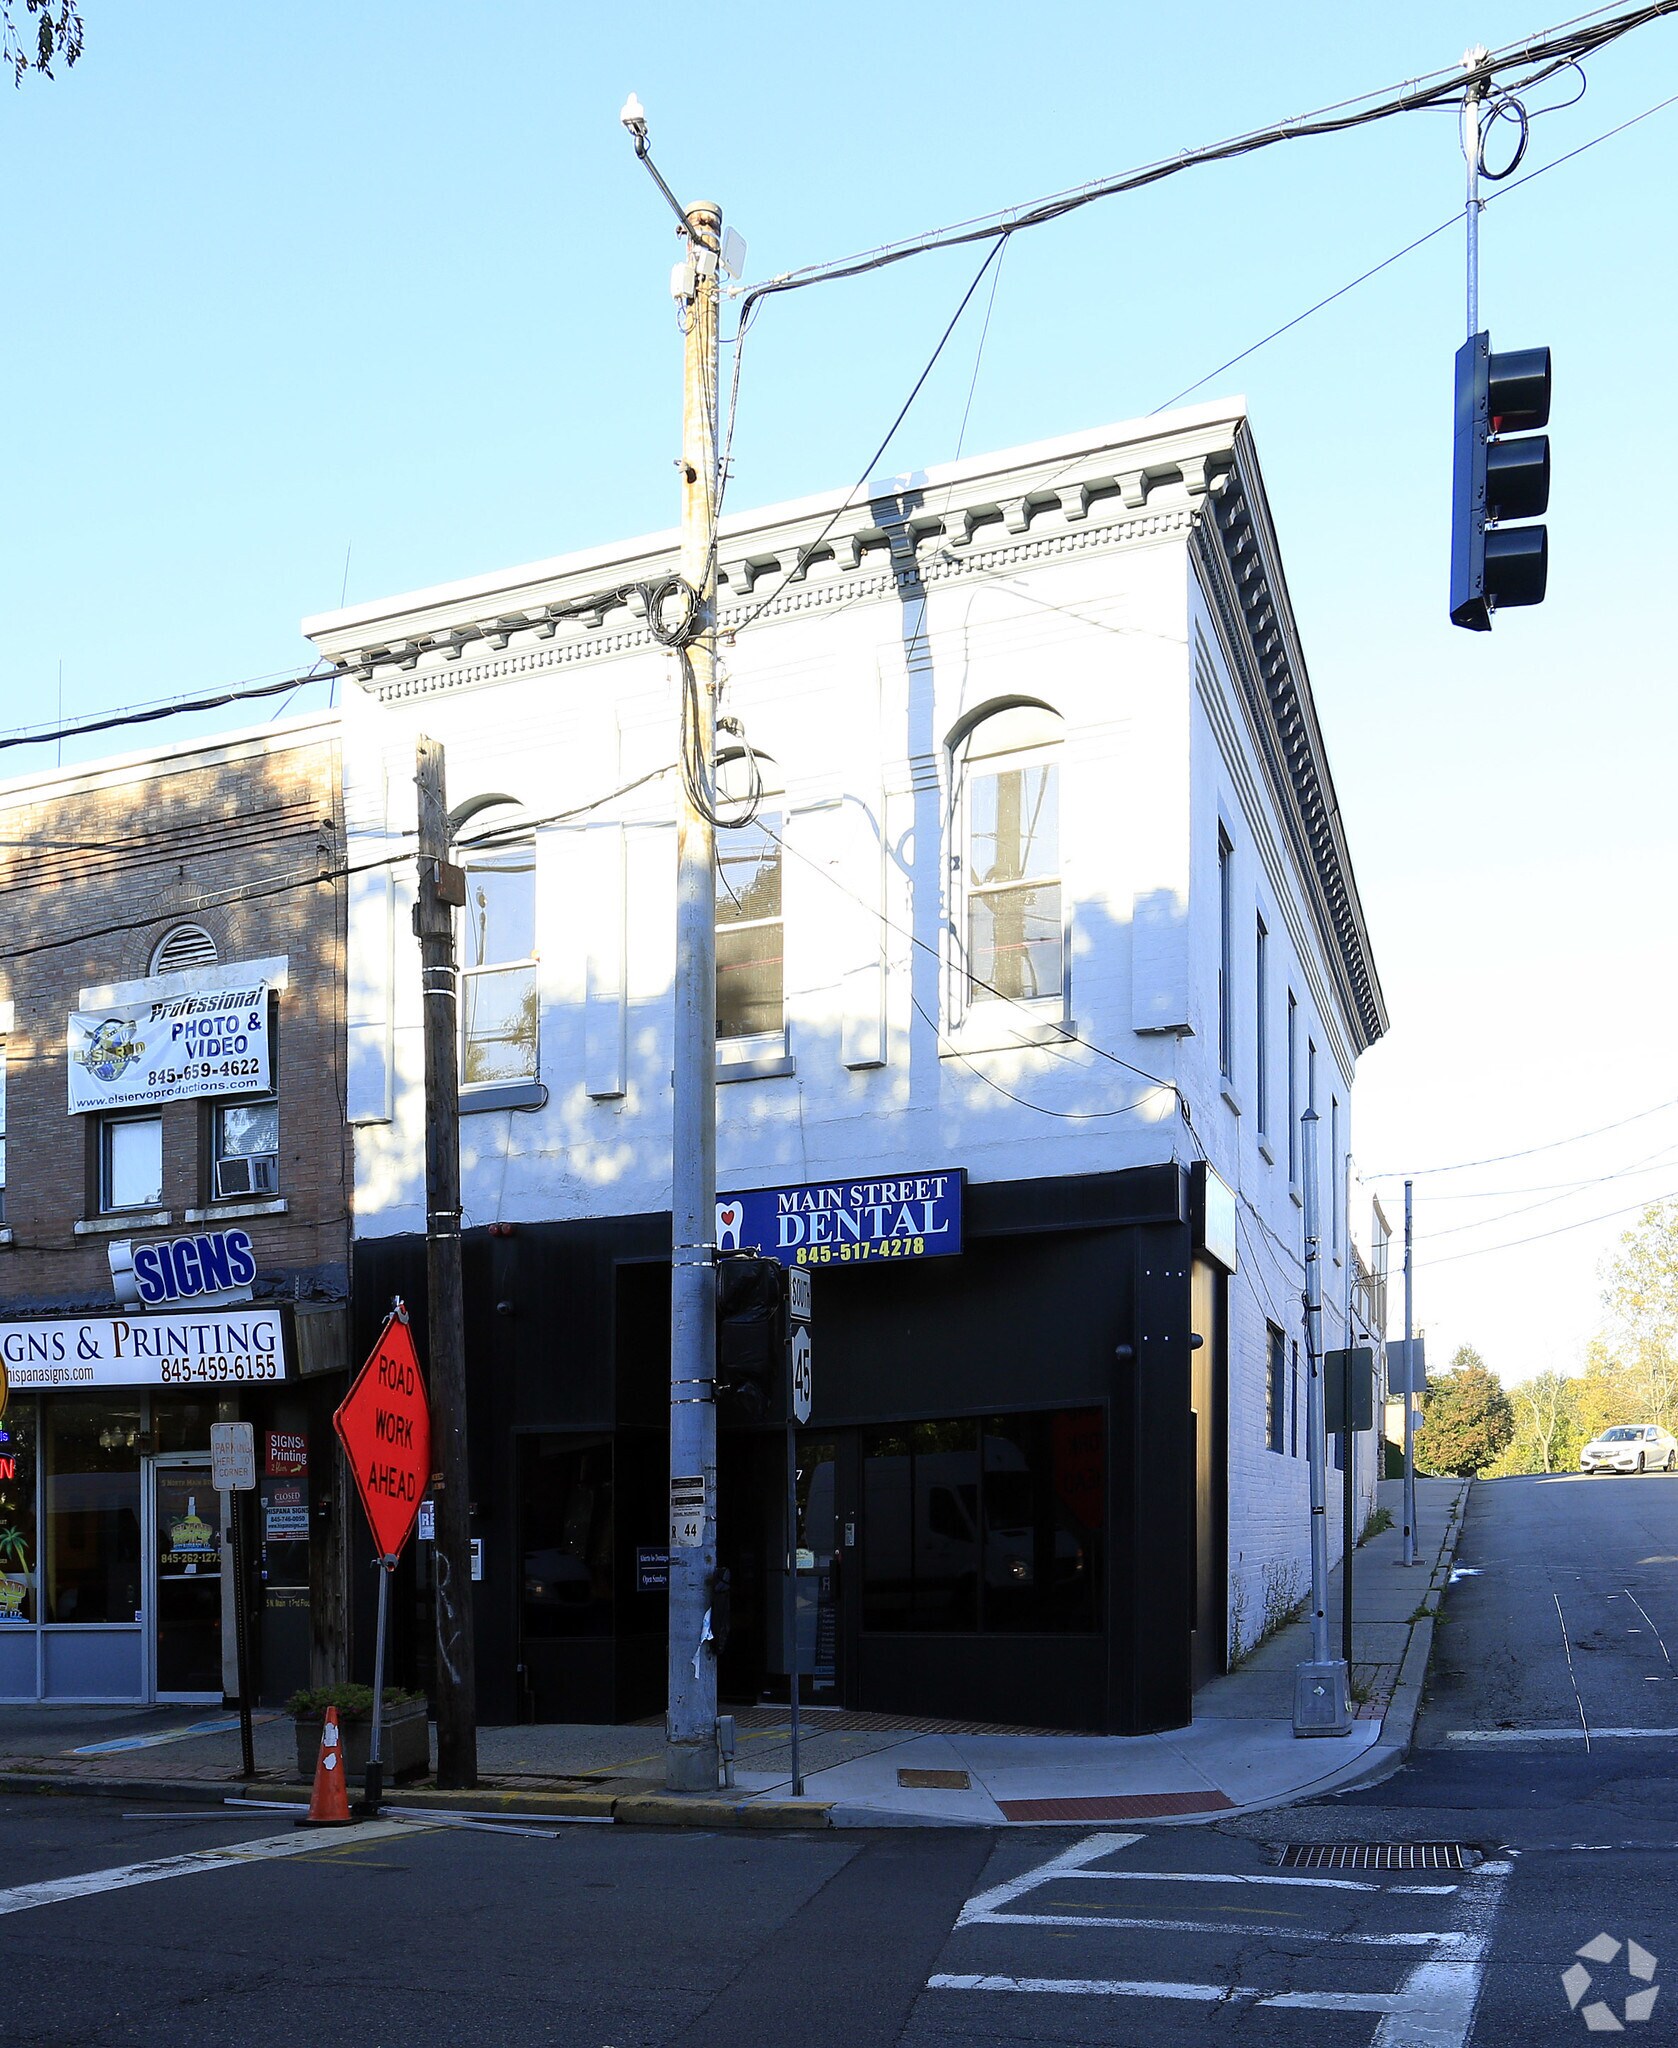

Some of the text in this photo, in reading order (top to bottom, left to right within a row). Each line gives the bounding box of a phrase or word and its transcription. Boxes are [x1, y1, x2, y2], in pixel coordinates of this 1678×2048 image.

[149, 986, 264, 1023] Professional
[171, 1012, 261, 1042] PHOTO &
[185, 1035, 249, 1060] VIDEO
[148, 1058, 260, 1086] 845-659-4622
[76, 1078, 258, 1107] www.elsiervoproductions.com
[777, 1176, 948, 1214] MAIN STREET
[776, 1200, 949, 1248] DENTAL
[796, 1236, 925, 1265] 845-517-4278
[134, 1231, 256, 1302] SIGNS
[77, 1325, 104, 1361] &
[110, 1320, 276, 1358] PRINTING
[161, 1353, 277, 1383] 845-459-6155
[378, 1353, 415, 1397] ROAD
[795, 1349, 810, 1402] 45
[270, 1434, 301, 1449] SIGNS
[375, 1407, 413, 1450] WORK
[217, 1457, 236, 1466] HERE
[271, 1448, 307, 1465] Printing
[219, 1467, 249, 1478] CORNER
[367, 1461, 416, 1502] AHEAD
[796, 1470, 803, 1481] 7
[274, 1491, 301, 1501] CLOSED
[684, 1523, 697, 1537] 44
